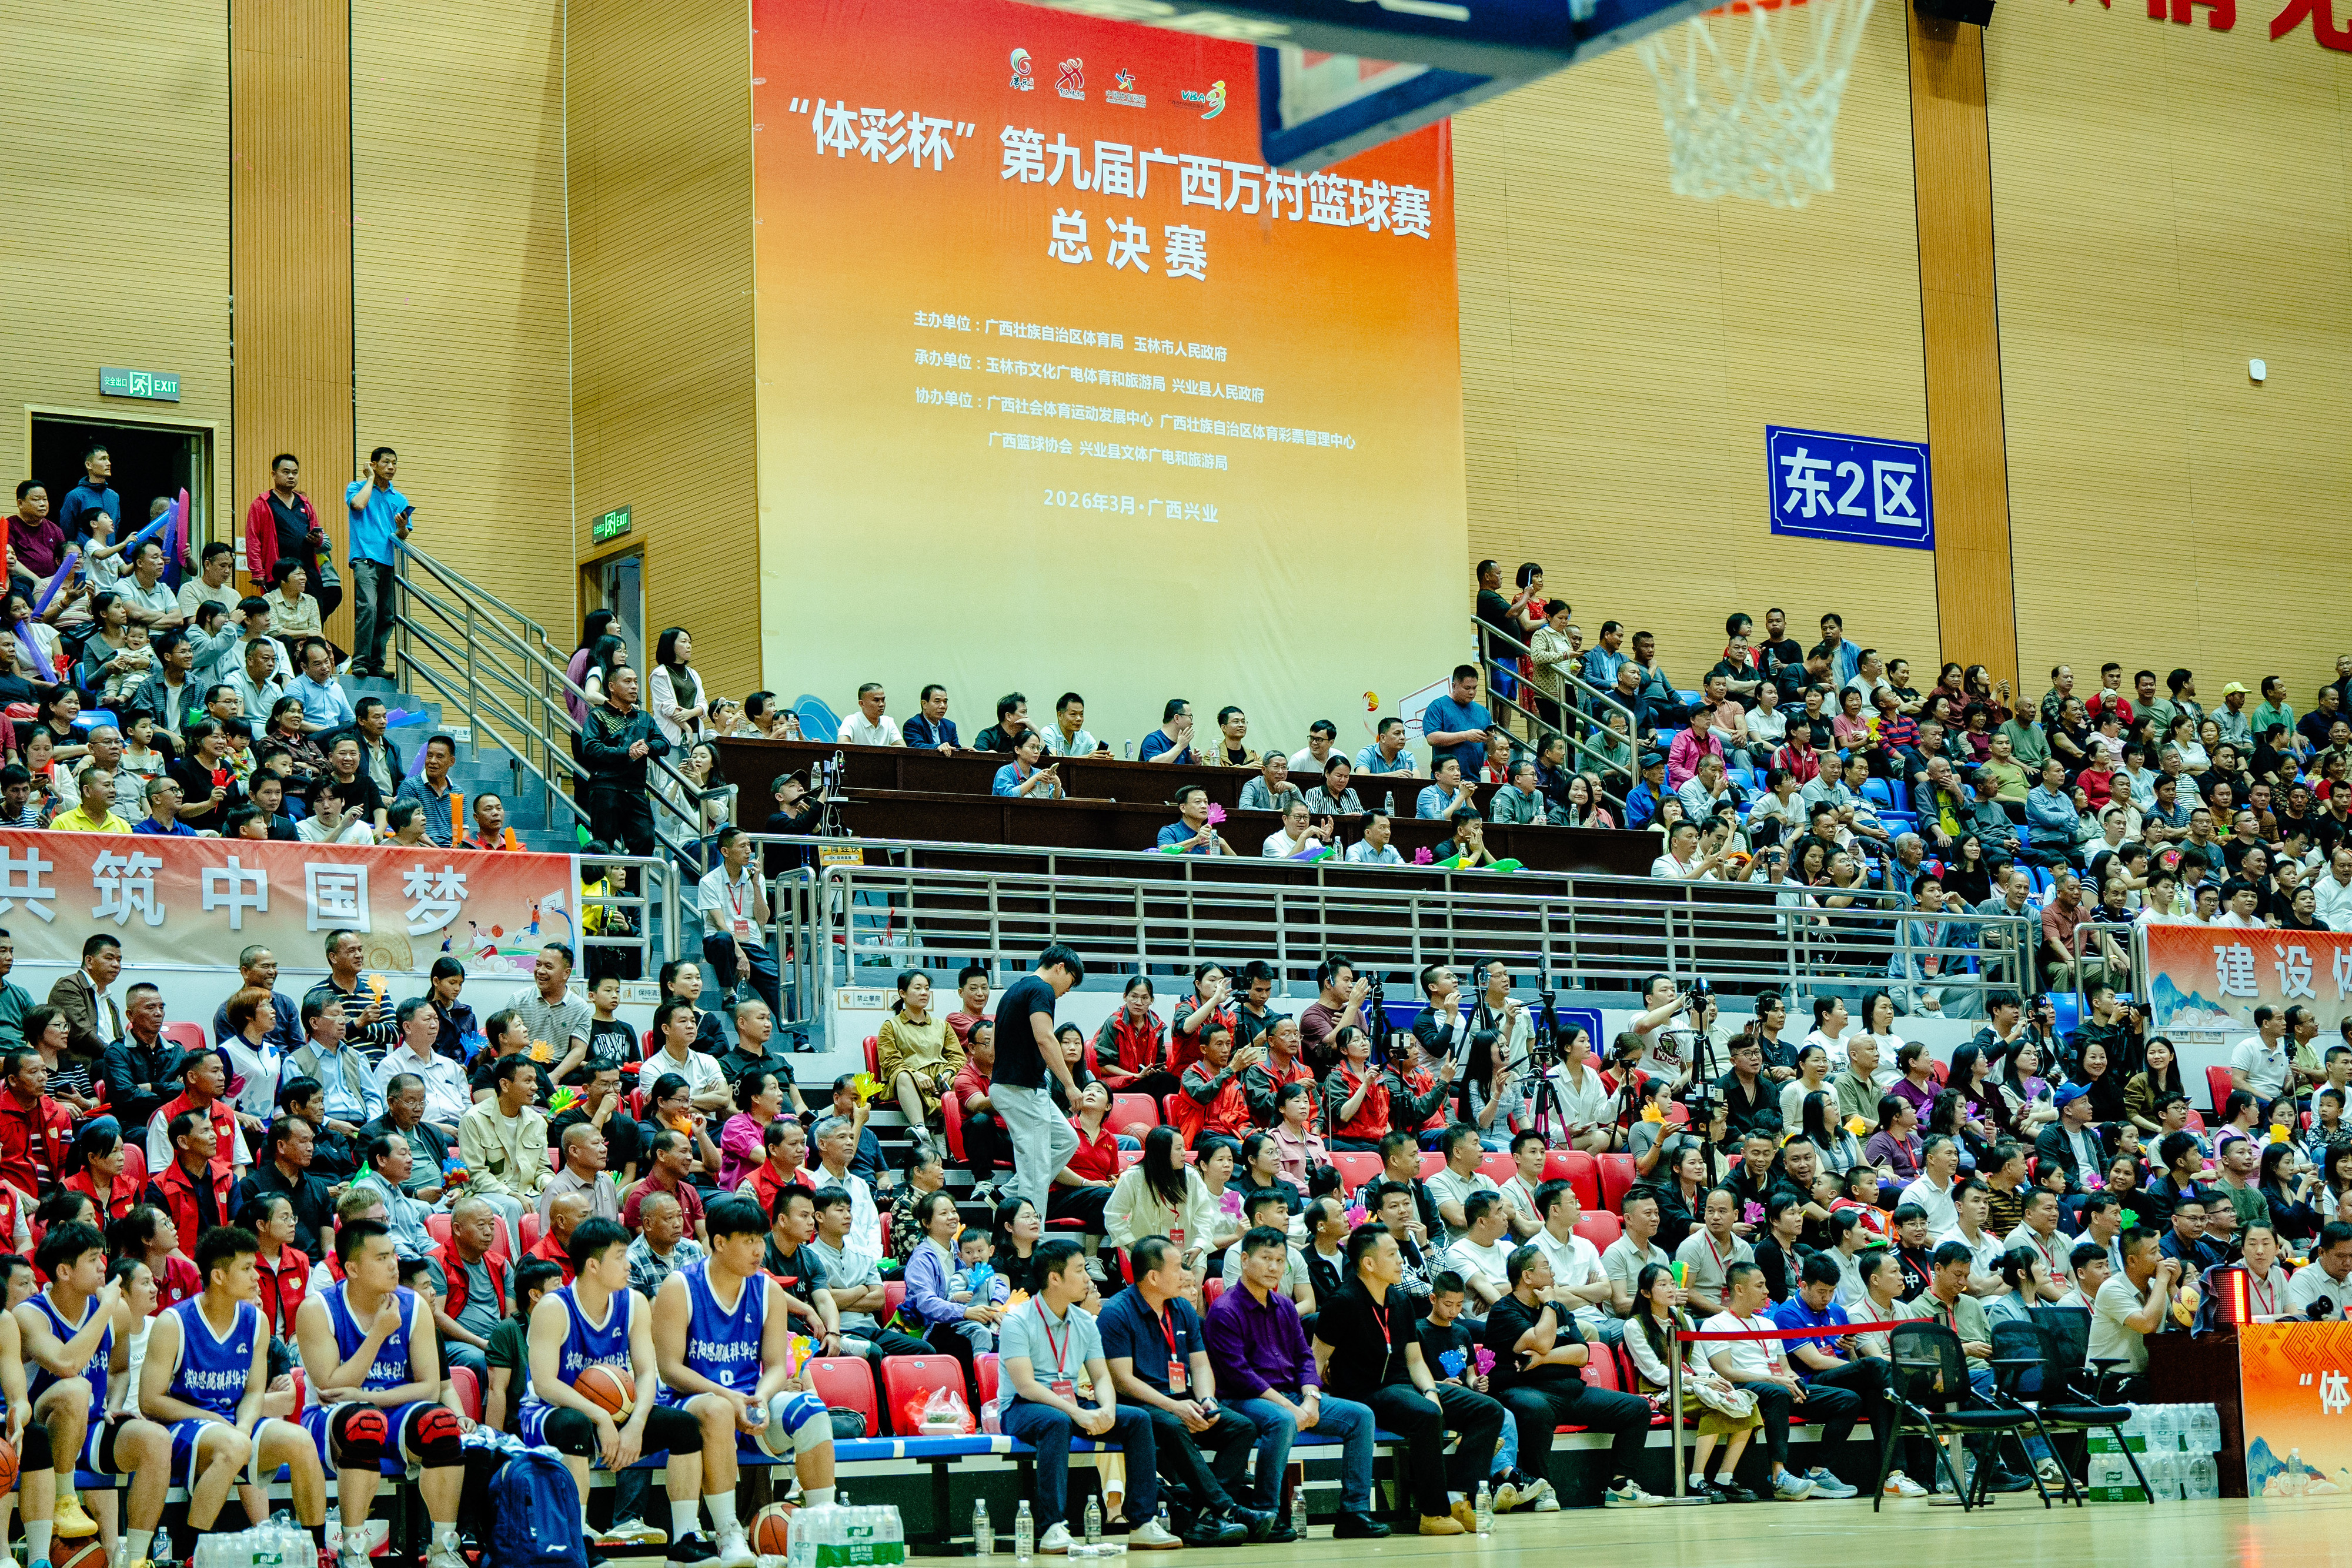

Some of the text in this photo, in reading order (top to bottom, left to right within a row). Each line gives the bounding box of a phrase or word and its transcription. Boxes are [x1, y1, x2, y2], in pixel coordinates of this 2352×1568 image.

[1105, 90, 1146, 103] 中国体育彩票
[1181, 91, 1205, 103] VBA
[999, 125, 1431, 239] 第九届广西万村篮球赛
[1047, 207, 1207, 282] 总决赛
[1134, 336, 1228, 363] 玉林市人民政府
[104, 376, 127, 387] 安全出口
[154, 380, 177, 392] EXIT
[1171, 377, 1265, 404] 兴业县人民政府
[1160, 413, 1357, 450] 广西壮族自治区体育彩票管理中心
[988, 431, 1229, 472] 广西篮球协会 兴业县文体广电和旅游局
[1780, 447, 1922, 527] 东2区
[616, 513, 627, 527] EXIT
[0, 847, 469, 936] 共筑中国梦
